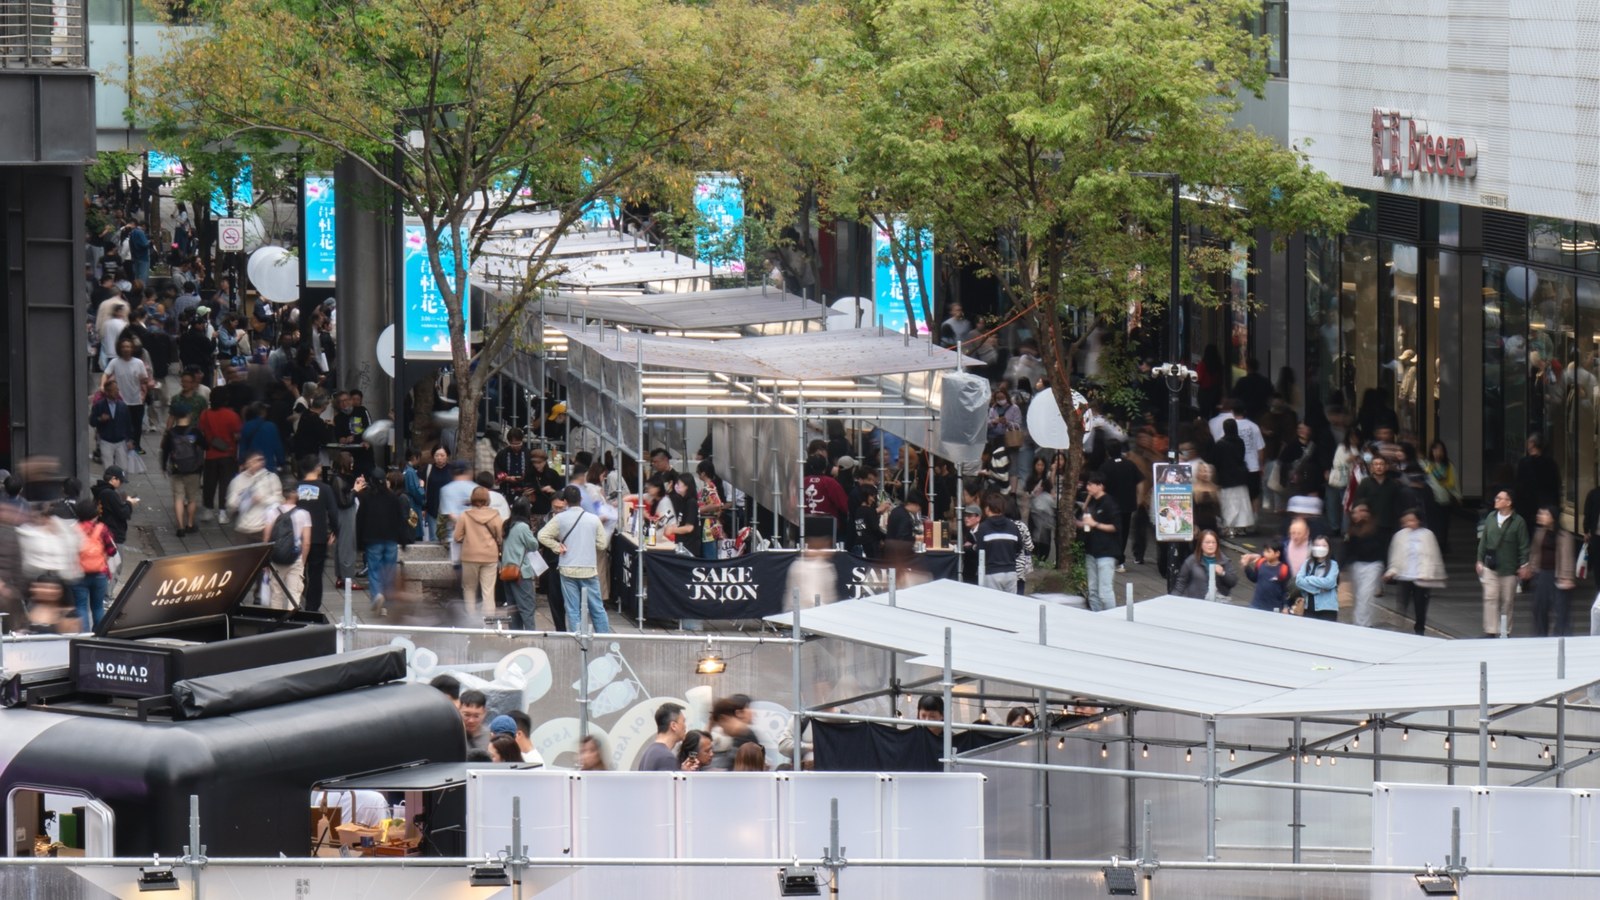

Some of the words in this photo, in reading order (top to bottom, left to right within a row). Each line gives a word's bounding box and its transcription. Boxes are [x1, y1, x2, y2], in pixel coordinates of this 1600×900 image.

[1408, 119, 1467, 177] Breeze
[156, 570, 233, 597] NOMAD
[692, 567, 753, 583] SAKE
[96, 661, 148, 677] NOMAD
